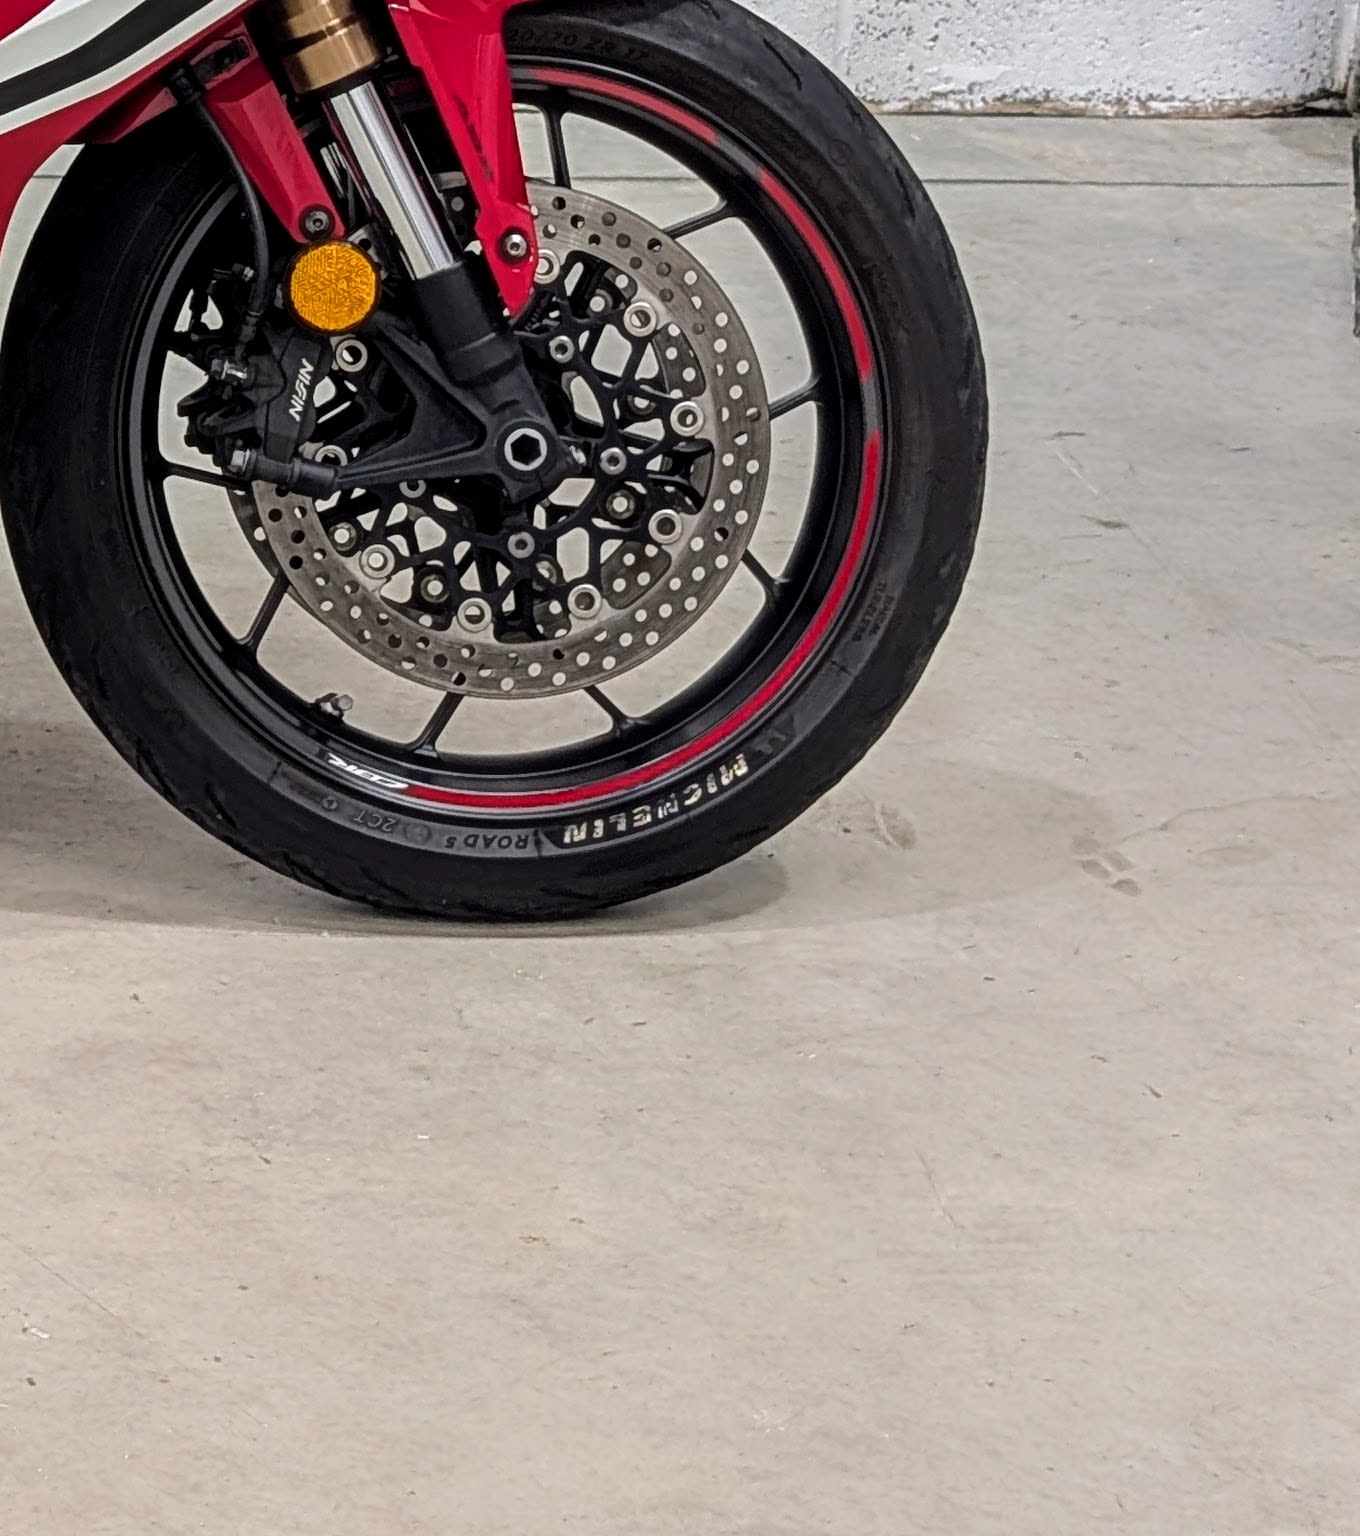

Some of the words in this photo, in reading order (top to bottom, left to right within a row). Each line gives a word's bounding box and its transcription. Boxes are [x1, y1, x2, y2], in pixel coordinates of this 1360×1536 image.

[507, 27, 578, 46] 20/70
[288, 357, 315, 422] NISSIN
[352, 809, 401, 833] 2CT
[444, 835, 458, 849] 5
[463, 833, 530, 850] ROAD
